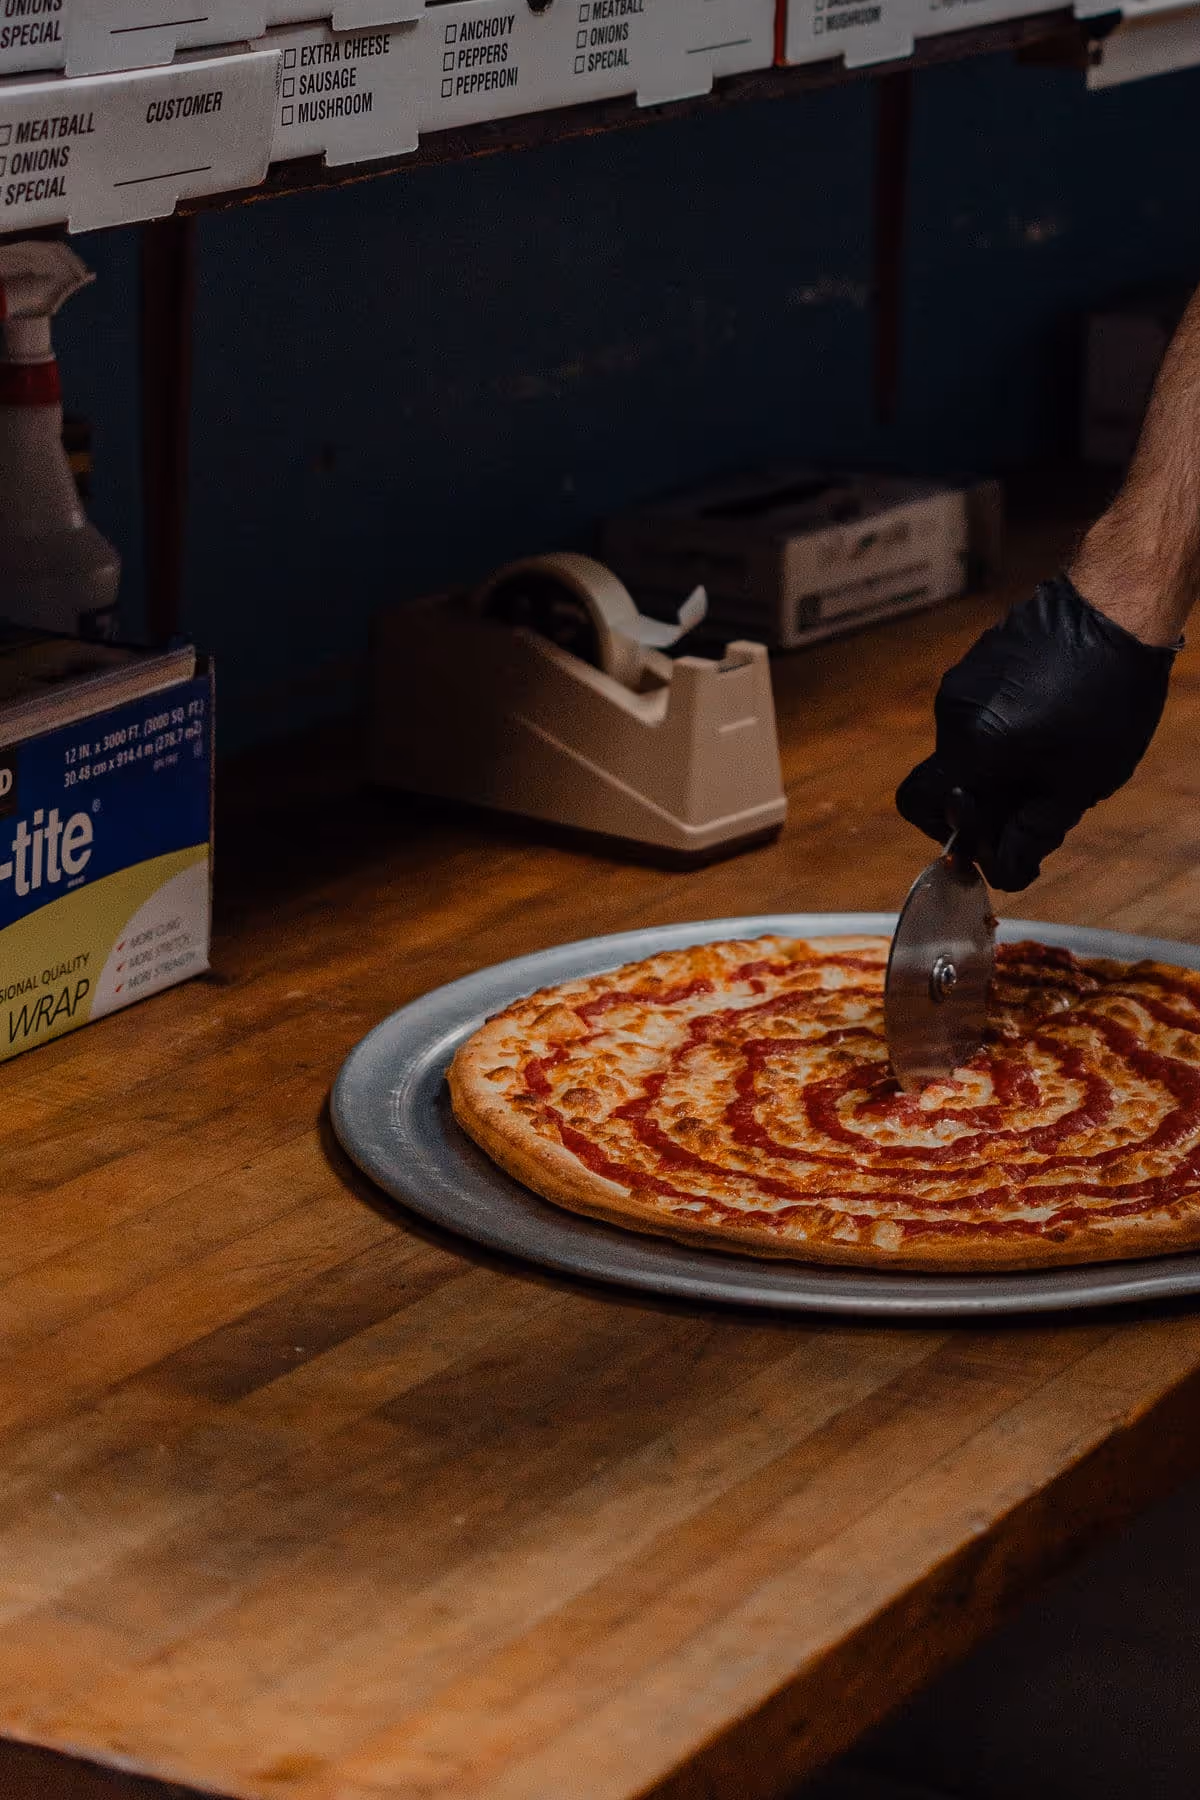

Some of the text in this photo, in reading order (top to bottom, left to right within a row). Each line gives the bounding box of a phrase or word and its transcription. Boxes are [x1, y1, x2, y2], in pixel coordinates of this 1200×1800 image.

[1, 20, 62, 49] SPECIAL
[459, 14, 515, 42] ANCHOVY
[590, 22, 629, 47] ONIONS
[300, 32, 390, 67] EXTRA CHEESE
[457, 42, 508, 69] PEPPERS
[588, 47, 630, 73] SPECIAL
[299, 66, 357, 95] SAUSAGE
[456, 66, 518, 95] PEPPERONI
[146, 90, 222, 124] CUSTOMER
[298, 91, 372, 123] MUSHROOM
[16, 112, 95, 145] MEATBALL
[10, 145, 70, 176] ONIONS
[6, 177, 67, 207] SPECIAL
[65, 748, 77, 764] 12
[103, 728, 127, 751] 3000
[64, 764, 91, 788] 30.48
[41, 952, 90, 985] QUALITY
[9, 978, 90, 1044] WRAP
